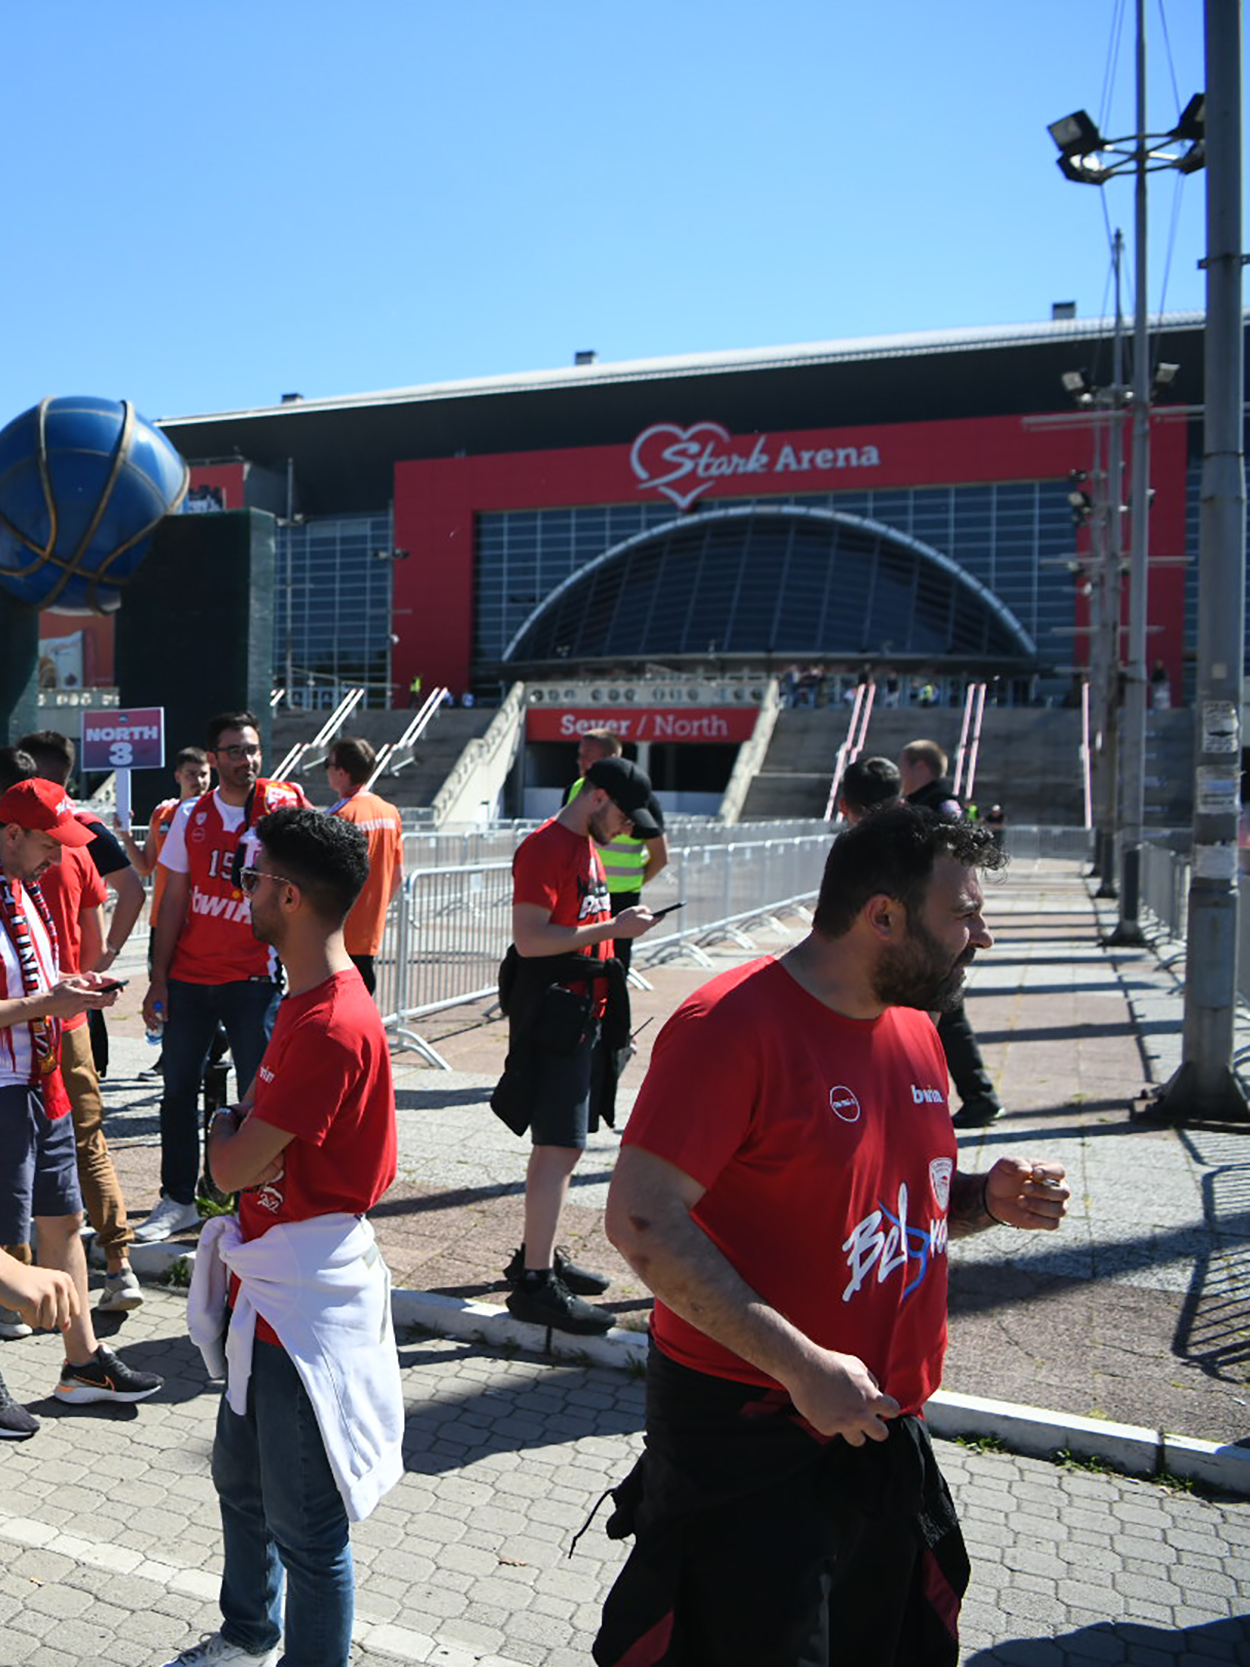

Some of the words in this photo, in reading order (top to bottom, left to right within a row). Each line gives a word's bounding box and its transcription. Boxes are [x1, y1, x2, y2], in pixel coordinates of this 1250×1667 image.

[637, 433, 768, 489] Stark
[775, 443, 881, 473] Arena
[85, 725, 158, 742] NORTH
[560, 714, 631, 736] Sever
[636, 715, 647, 736] /
[654, 714, 728, 737] North
[108, 742, 133, 766] 3
